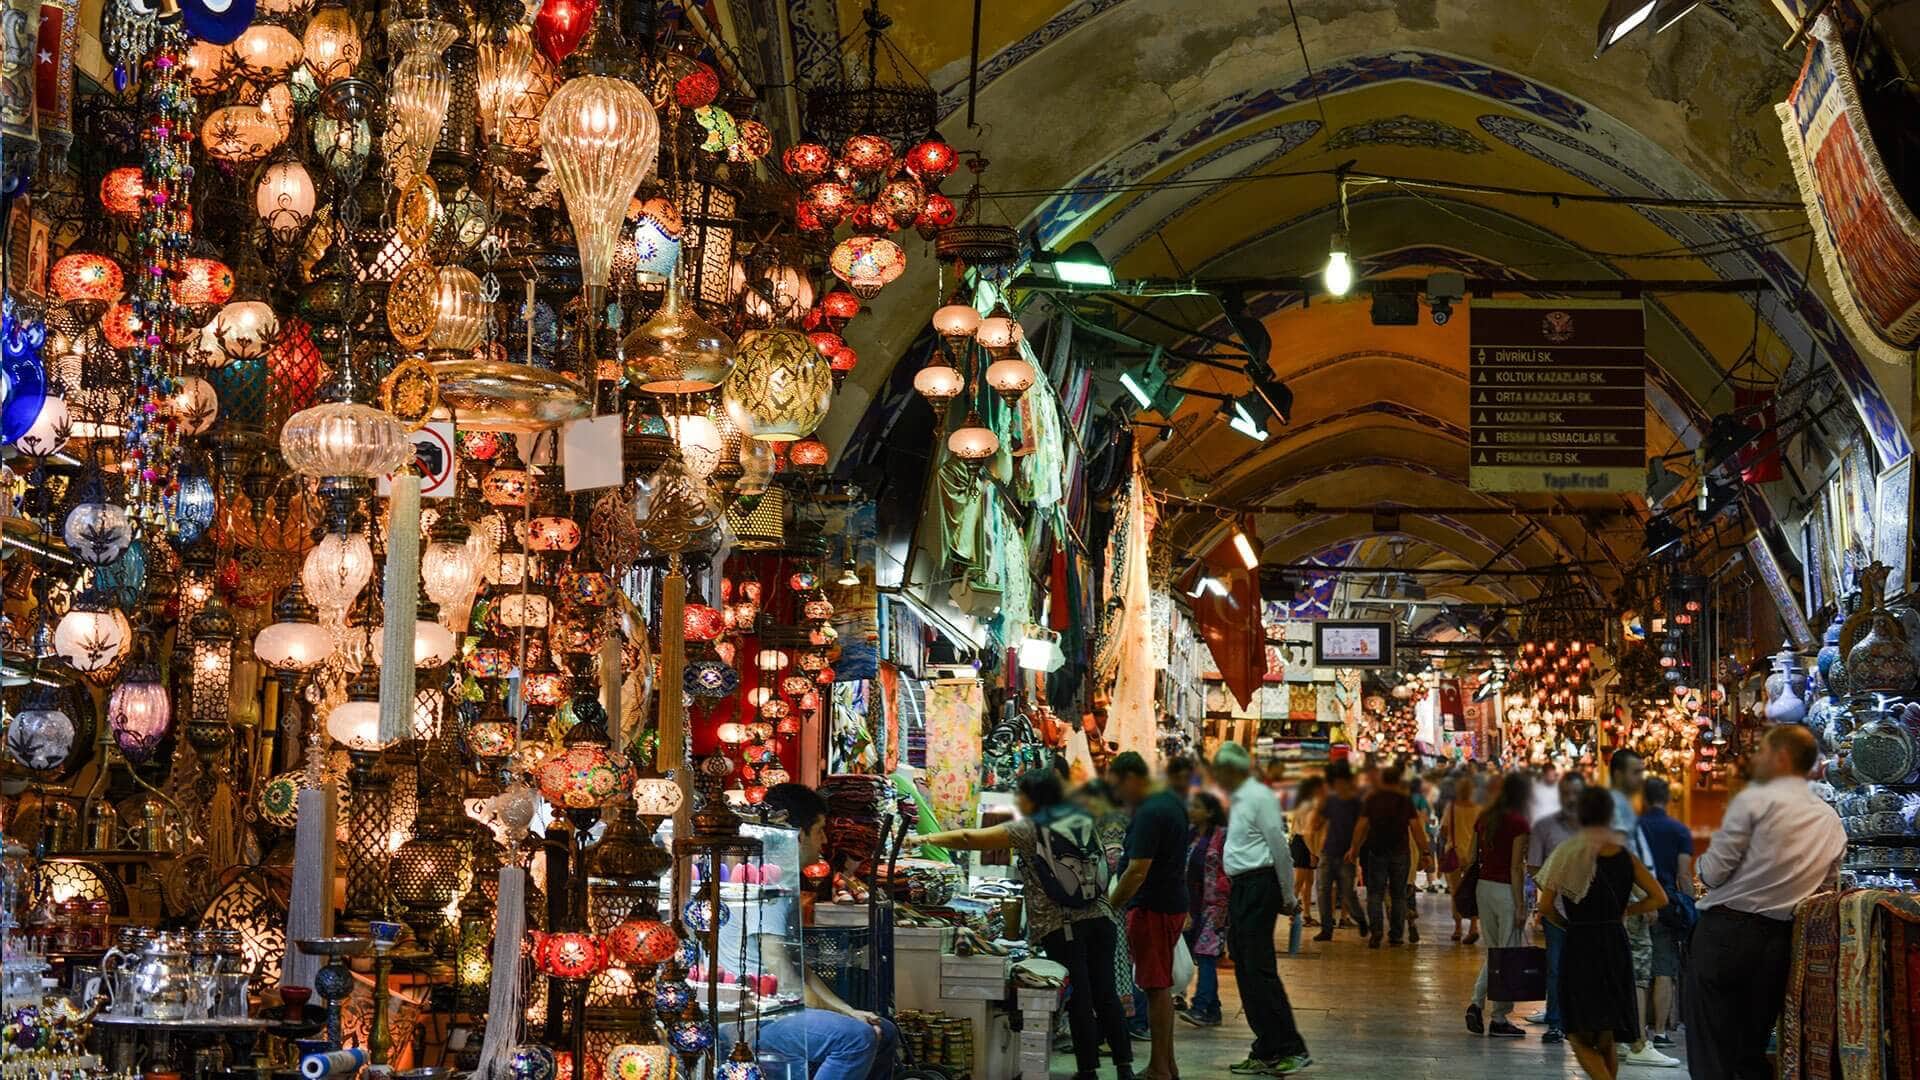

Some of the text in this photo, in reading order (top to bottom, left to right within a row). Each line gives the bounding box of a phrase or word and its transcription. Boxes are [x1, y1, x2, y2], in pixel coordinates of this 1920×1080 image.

[1495, 349, 1554, 363] DİVRİKLİ SK.
[1495, 371, 1607, 383] KOLTUK KAZAZLAR SK.
[1495, 391, 1522, 402] ORTA
[1524, 391, 1576, 403] KAZAZLAR
[1548, 412, 1565, 423] SK.
[1564, 452, 1581, 463] SK.
